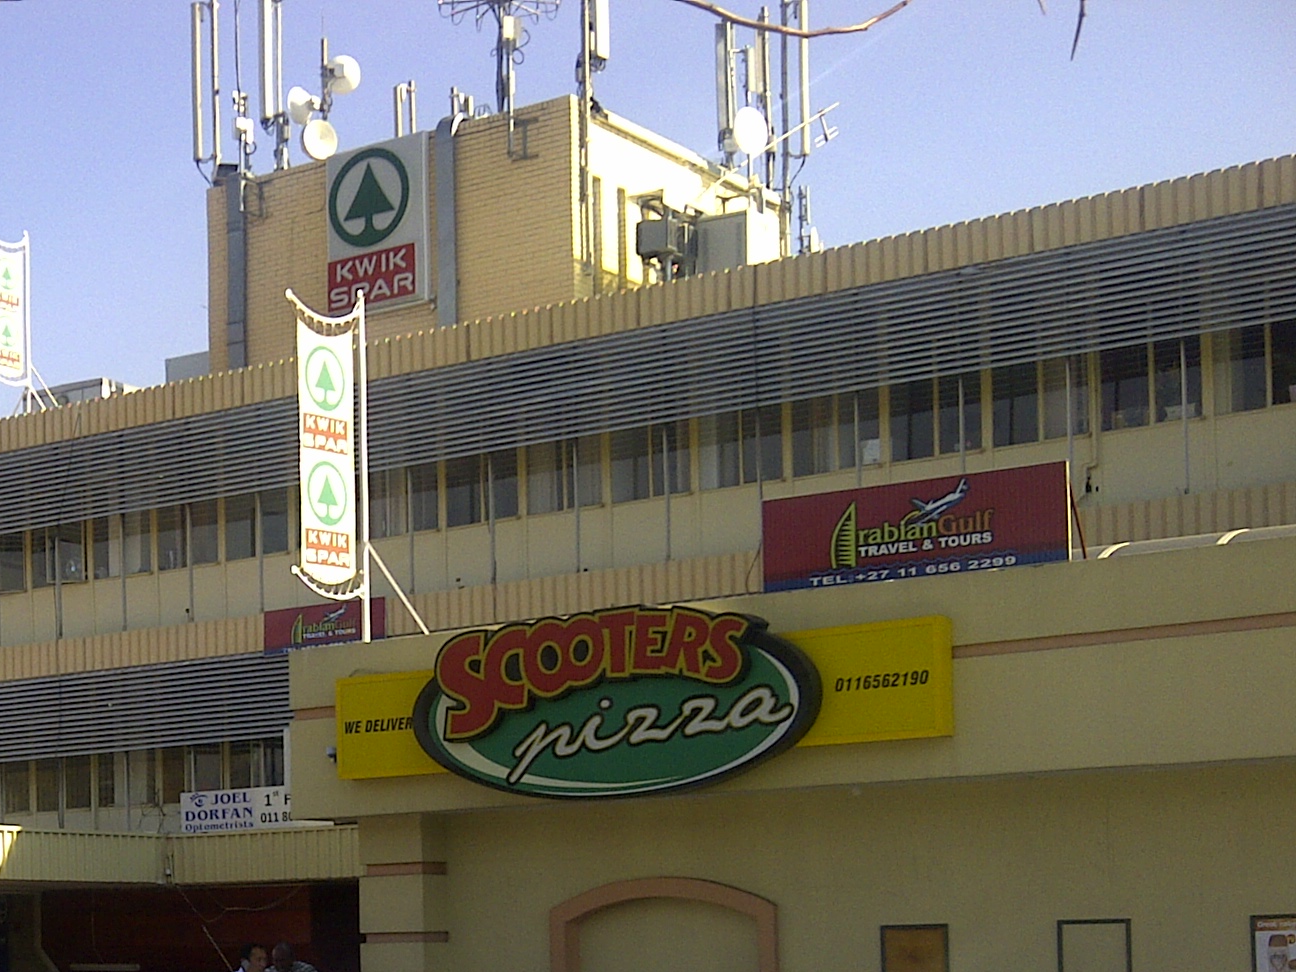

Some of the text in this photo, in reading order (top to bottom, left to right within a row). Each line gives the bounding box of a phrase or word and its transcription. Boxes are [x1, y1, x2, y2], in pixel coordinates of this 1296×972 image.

[335, 247, 408, 284] KWIK
[329, 271, 414, 310] SPAR
[305, 413, 346, 435] KWIK
[303, 432, 348, 454] SPAR
[307, 530, 348, 549] KWIK
[858, 531, 993, 557] TRAVEL & TOURS
[306, 548, 350, 568] SPAR
[855, 569, 890, 581] +27
[897, 565, 917, 577] 11
[925, 561, 961, 574] 656
[968, 555, 1017, 570] 2299
[435, 608, 747, 741] SCOOTERS
[835, 670, 930, 692] 0116562190
[344, 716, 413, 735] WE DELIVER
[508, 685, 794, 783] pizza
[210, 791, 252, 805] JOEL
[185, 806, 254, 822] DORFAN
[260, 811, 280, 823] 011
